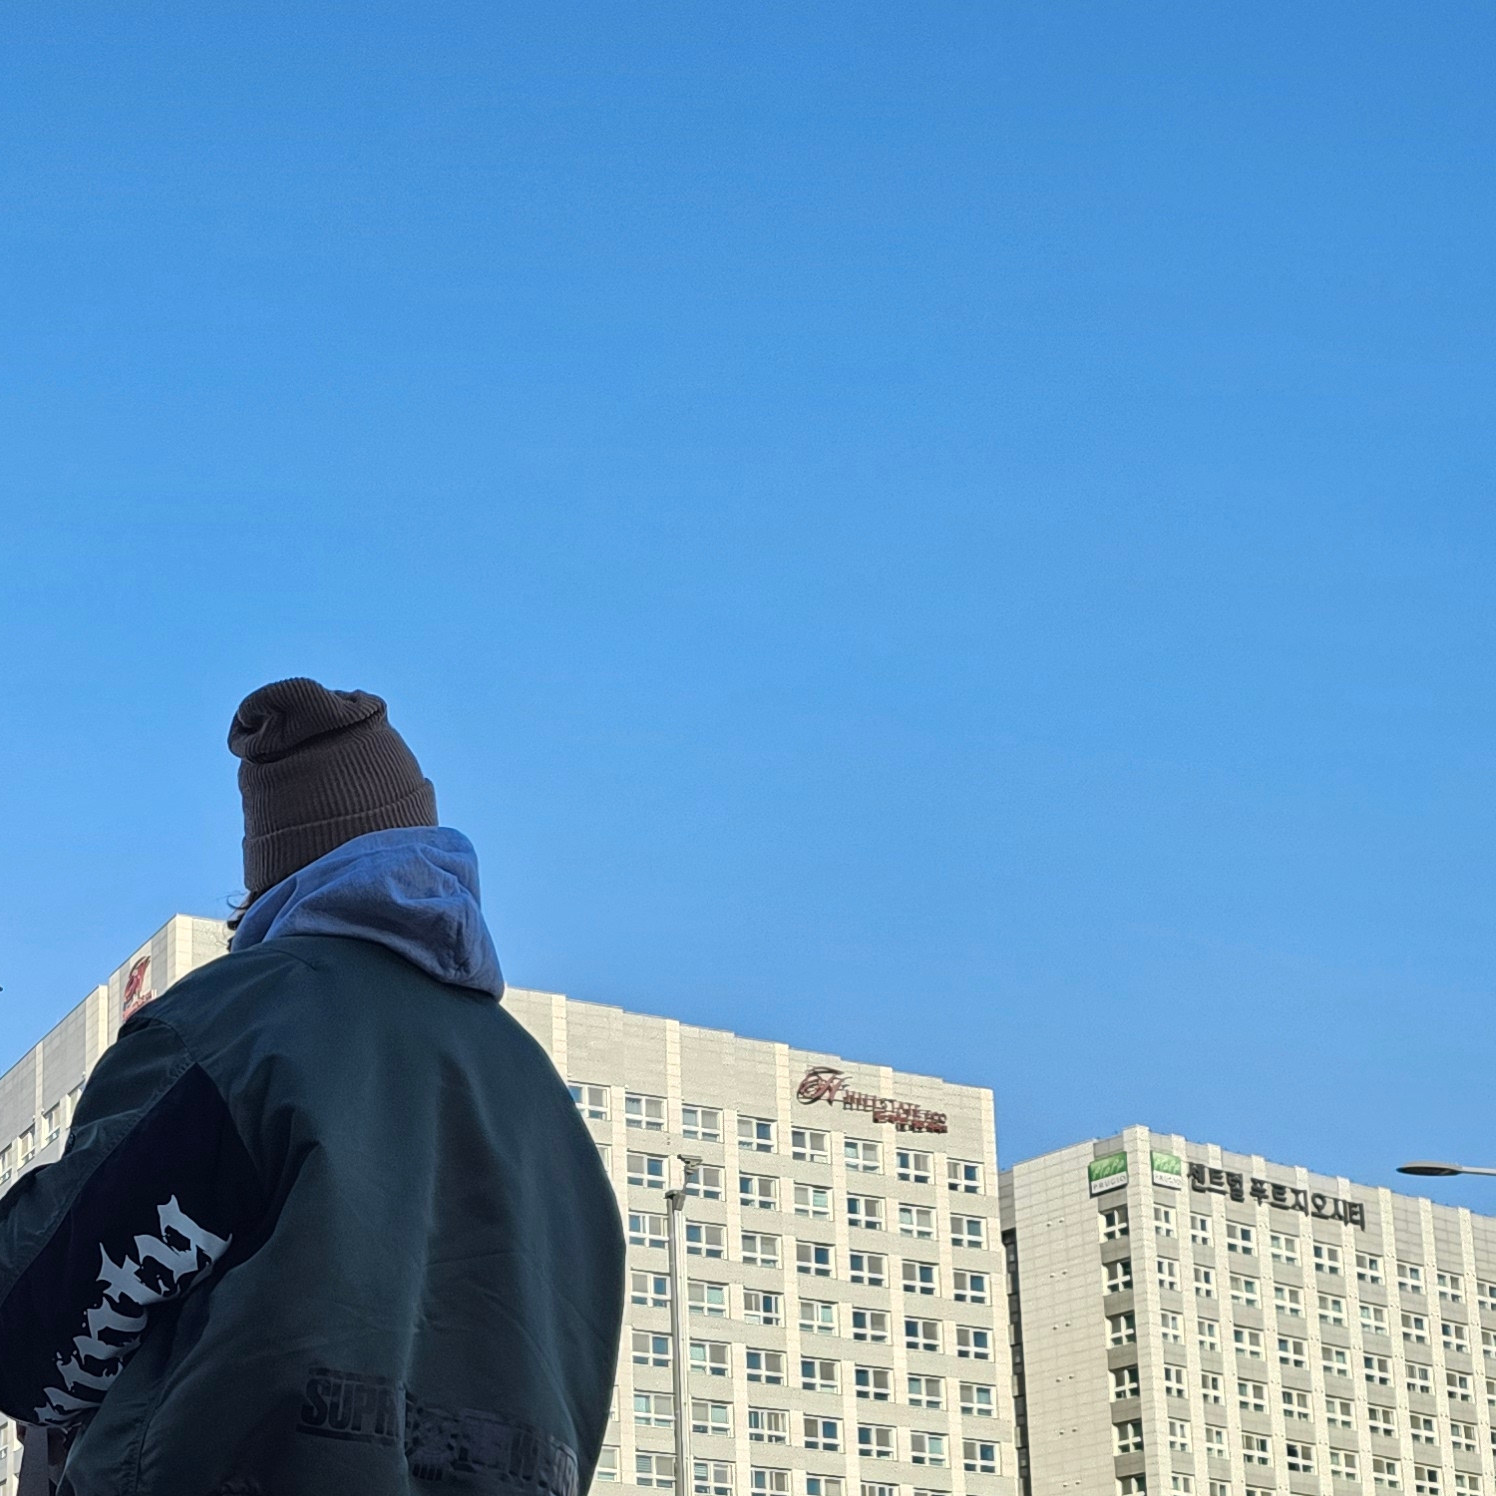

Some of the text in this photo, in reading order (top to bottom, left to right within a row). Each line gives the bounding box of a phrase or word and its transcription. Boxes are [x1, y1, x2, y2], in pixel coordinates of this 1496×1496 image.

[1092, 1175, 1127, 1190] PRUGIO
[1187, 1161, 1366, 1231] 센트럴 푸르지오시티
